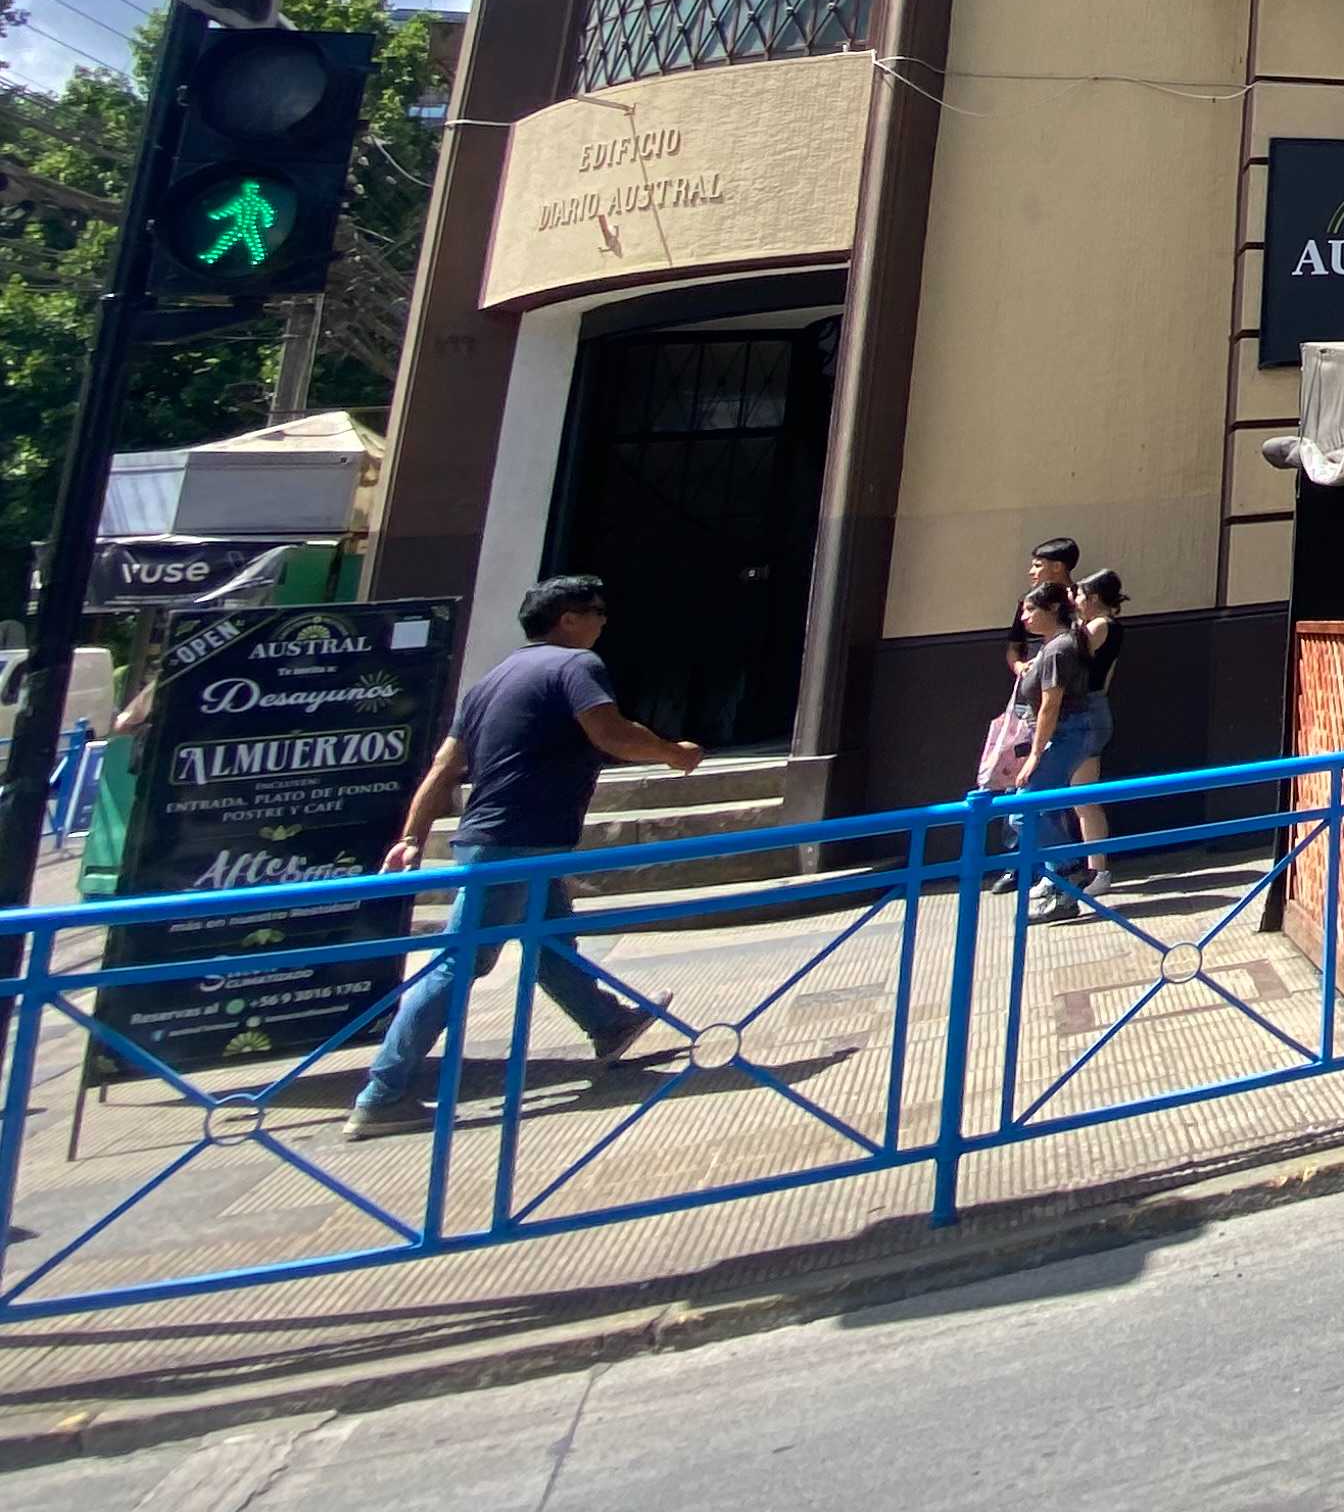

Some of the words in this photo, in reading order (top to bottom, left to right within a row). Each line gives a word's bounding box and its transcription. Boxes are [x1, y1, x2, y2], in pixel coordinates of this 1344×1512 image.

[578, 128, 681, 172] EDIFICIO
[538, 191, 601, 231] DIARIO
[607, 173, 724, 217] AUSTRAL
[175, 621, 242, 665] OPEN
[249, 636, 372, 660] AUSTRAL
[201, 678, 400, 715] Desayunos
[179, 730, 404, 785] ALMUERZOS
[223, 807, 284, 822] POSTRE
[290, 805, 302, 816] Y
[304, 799, 343, 813] CAFÉ
[254, 790, 305, 805] PLATO
[311, 787, 333, 800] DE
